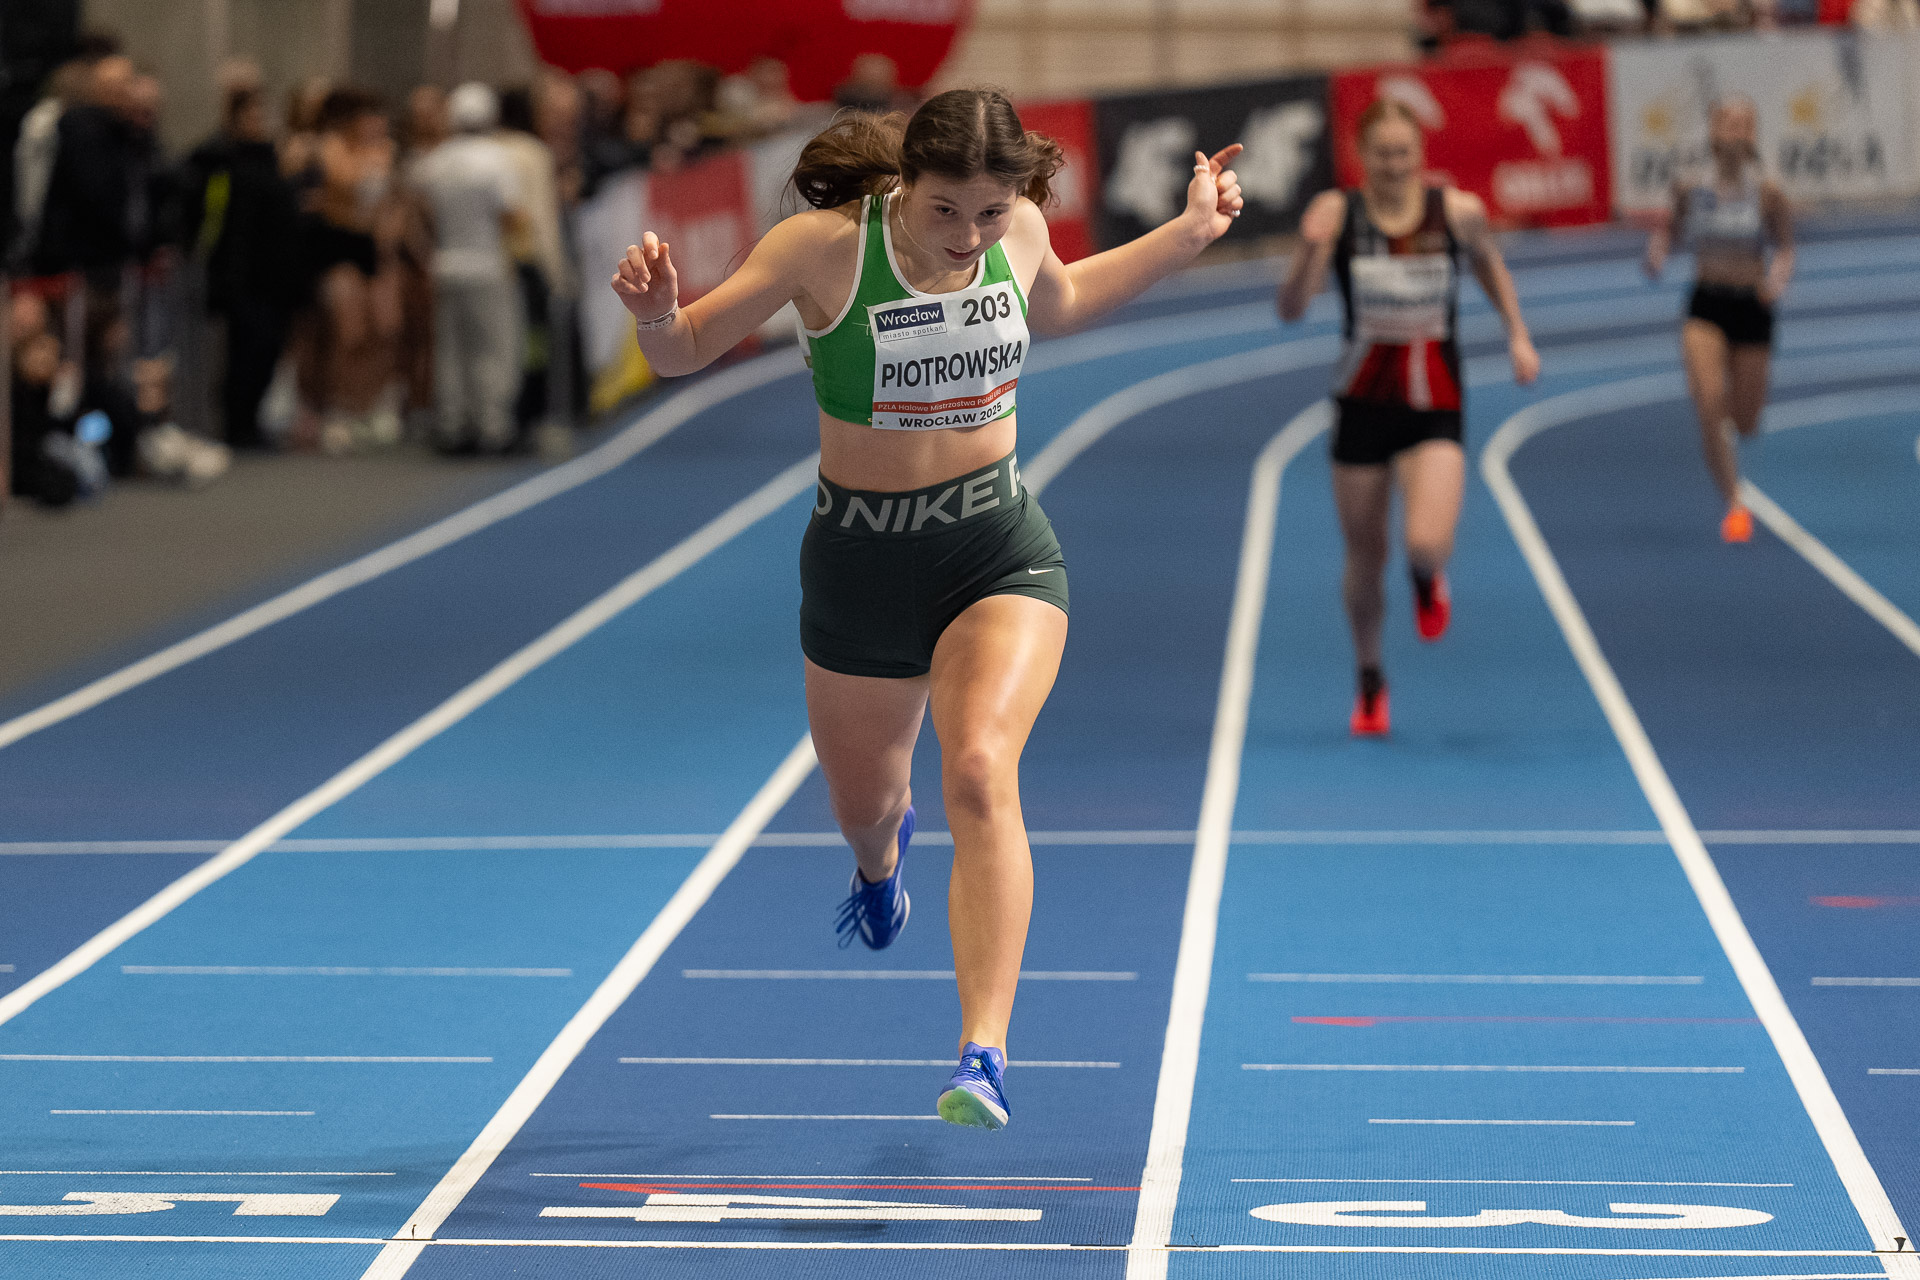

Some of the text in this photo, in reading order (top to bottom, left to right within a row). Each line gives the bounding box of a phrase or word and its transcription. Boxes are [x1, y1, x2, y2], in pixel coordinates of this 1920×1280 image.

[878, 307, 941, 328] Wrocław
[961, 291, 1011, 327] 203
[882, 324, 944, 341] miasto spotkań
[881, 340, 1022, 388] PIOTROWSKA
[877, 403, 897, 411] PZLA
[898, 404, 929, 412] Halowe
[930, 400, 976, 412] Mistrzostwa
[898, 401, 1002, 428] WROCŁAW 2025
[840, 468, 1000, 533] NIKE
[1248, 1200, 1775, 1229] 3
